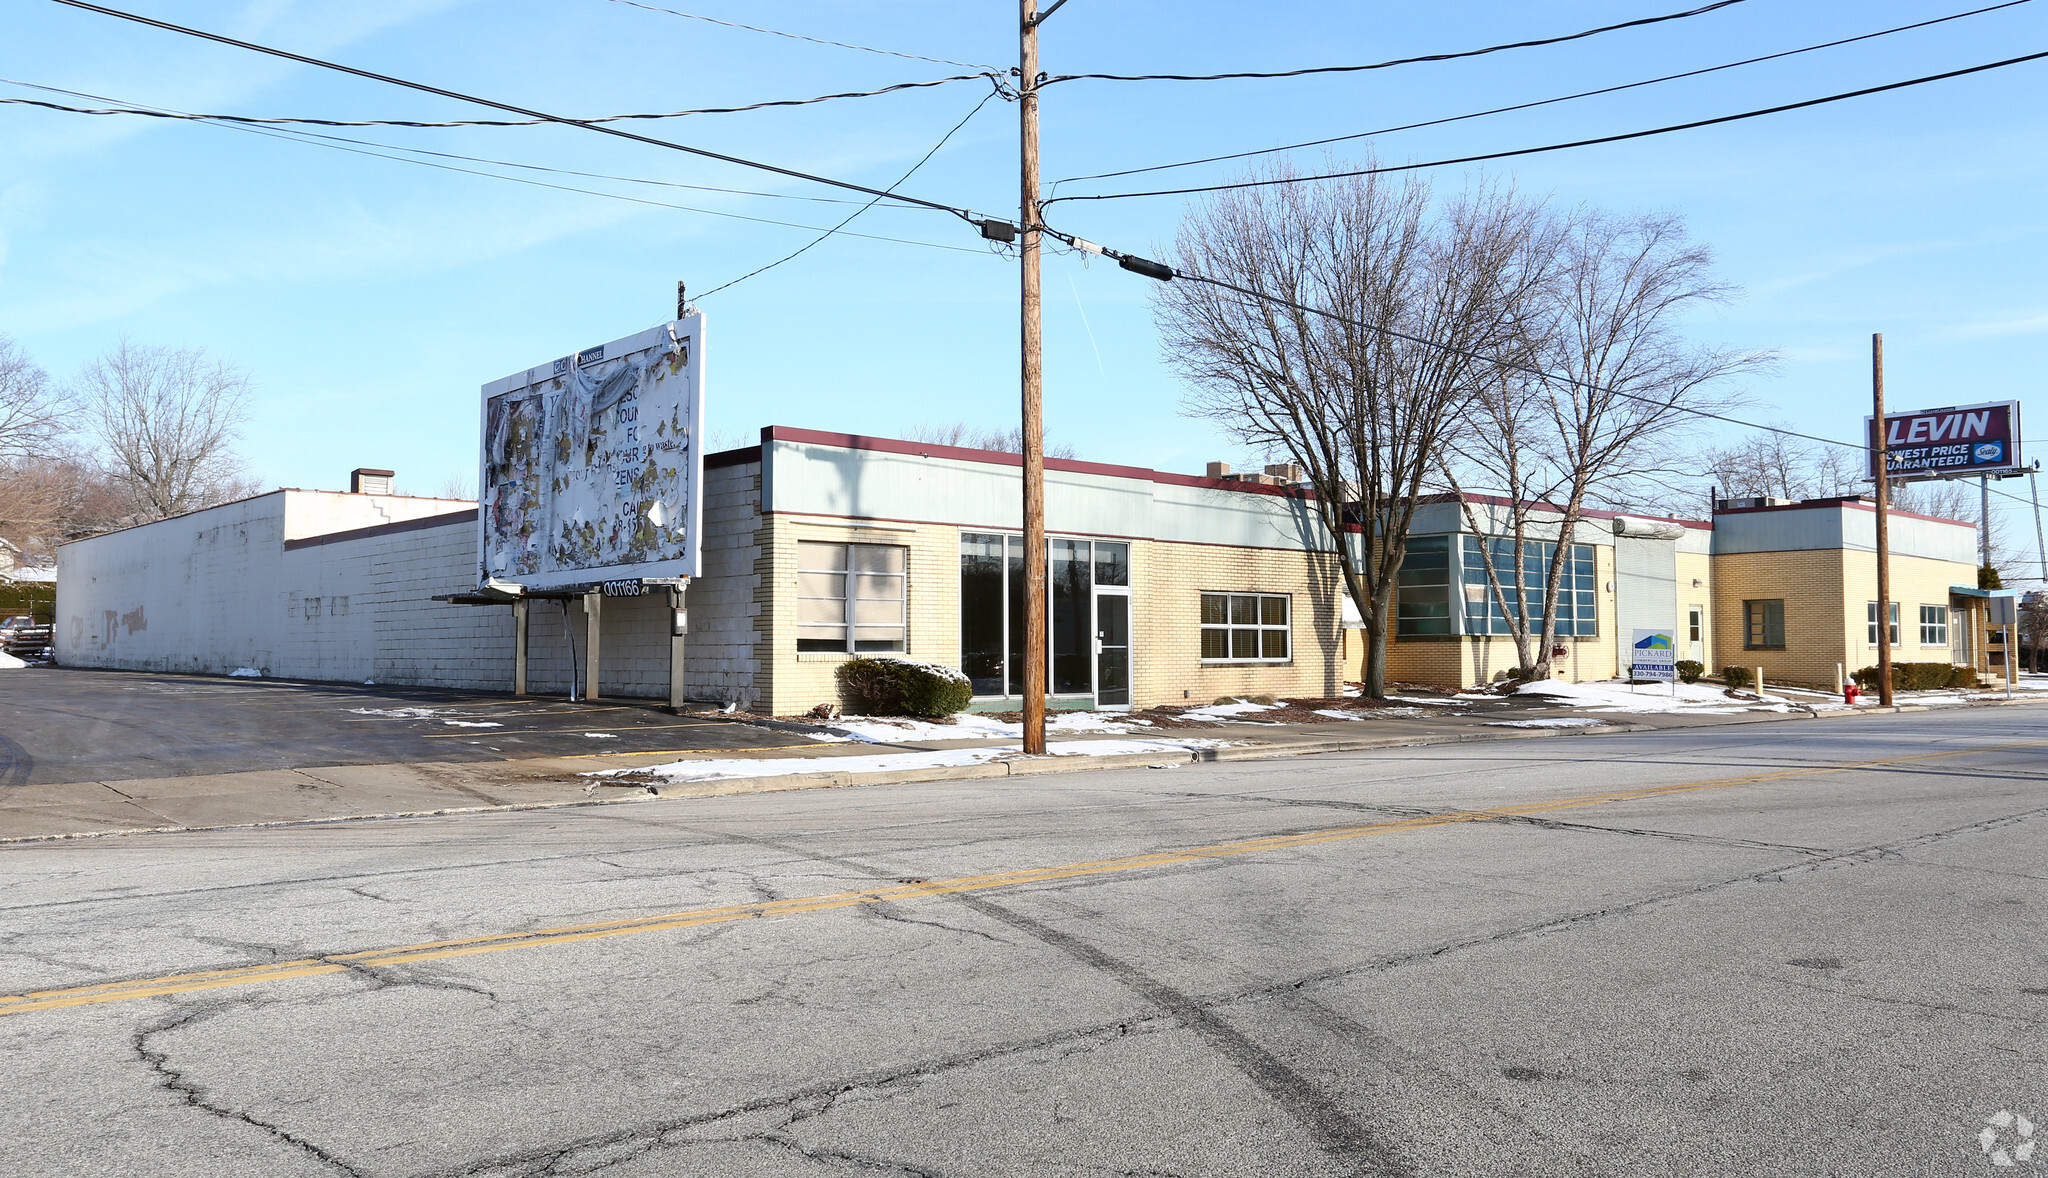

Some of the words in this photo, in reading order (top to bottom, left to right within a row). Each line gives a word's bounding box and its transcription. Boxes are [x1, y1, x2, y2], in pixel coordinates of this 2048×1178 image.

[1887, 411, 1990, 445] LEVIN
[1886, 447, 1928, 460] OWEST
[1931, 443, 1970, 457] PRICE
[1977, 444, 1998, 456] Sealy
[1886, 454, 1968, 471] UARANTEED!
[603, 579, 640, 597] 001166
